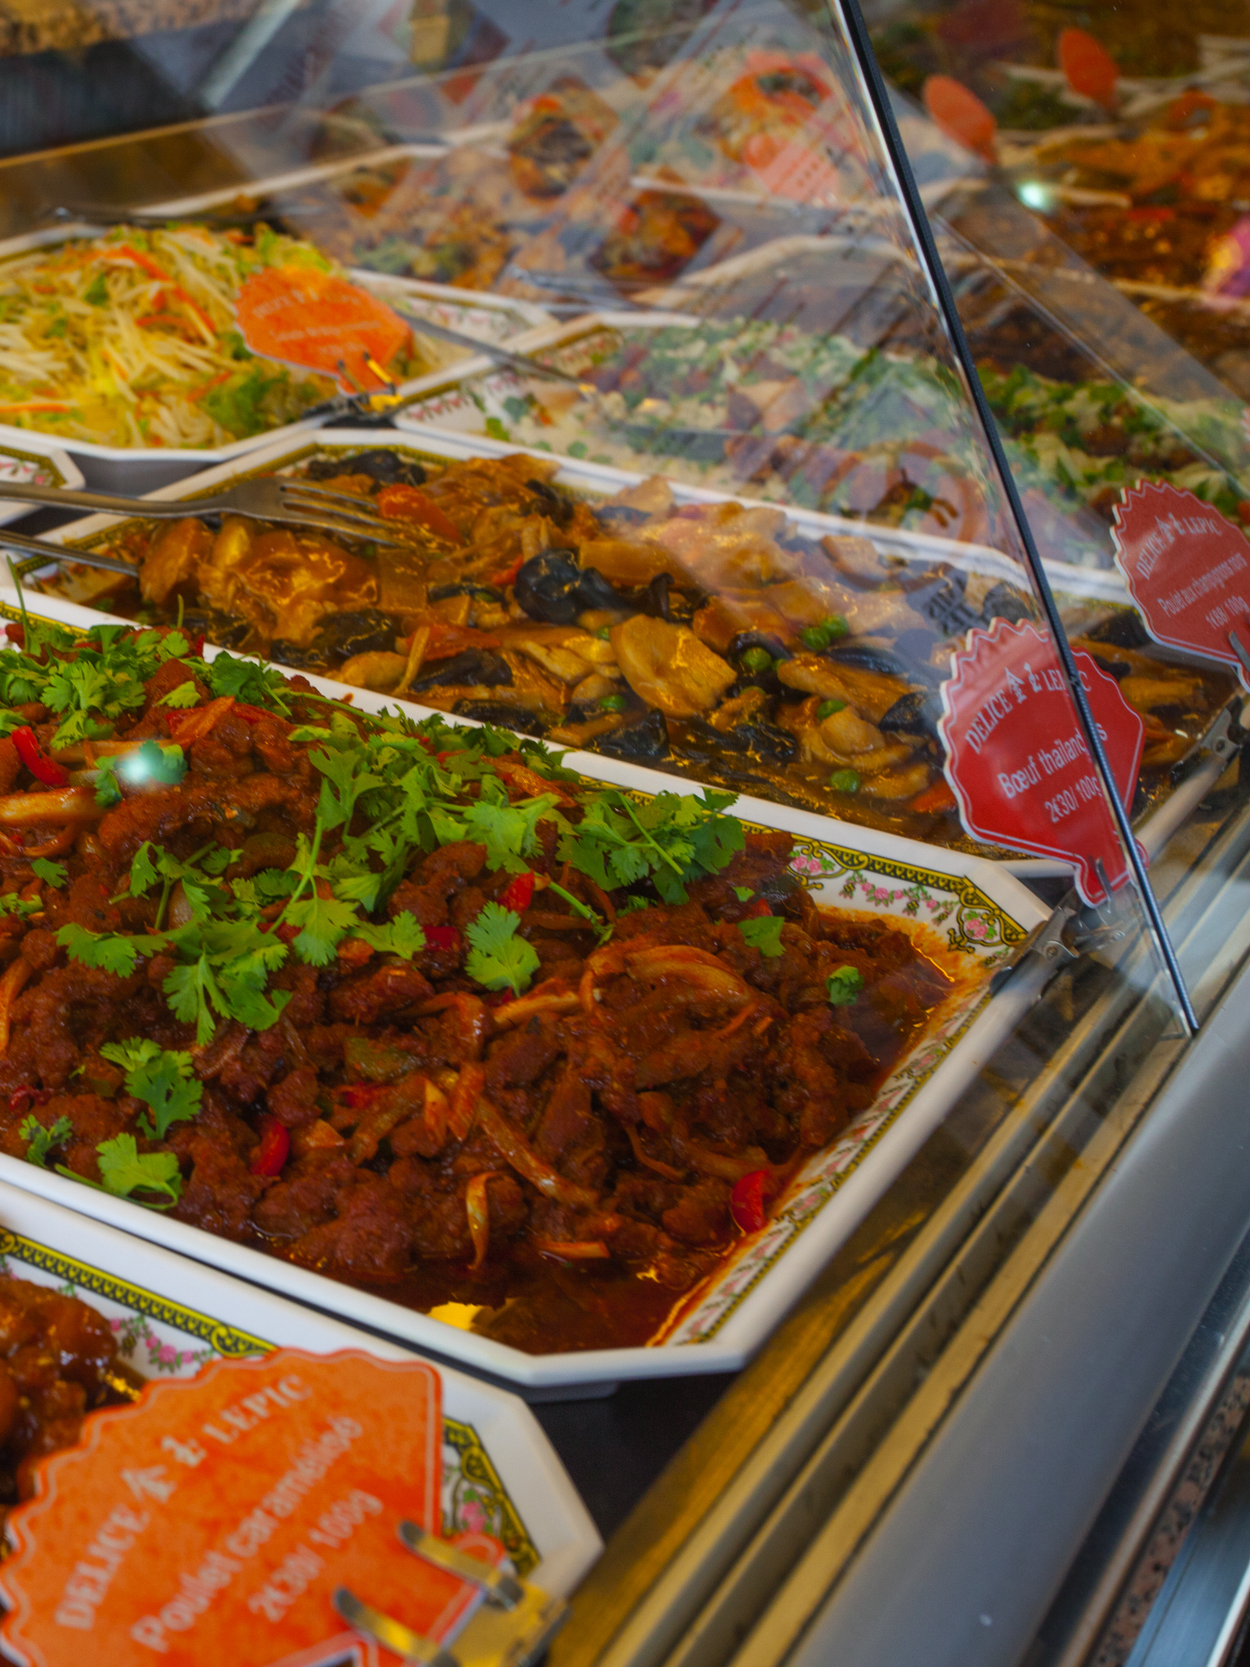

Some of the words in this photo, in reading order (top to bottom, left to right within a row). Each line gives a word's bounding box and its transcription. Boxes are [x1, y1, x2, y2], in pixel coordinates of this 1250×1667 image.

[1135, 531, 1167, 580] DELICE
[1182, 516, 1222, 536] LEPIC
[1157, 589, 1188, 618] Poulet
[1180, 585, 1199, 605] aux
[1191, 561, 1234, 597] champignons
[964, 689, 1013, 755] DELICE
[1040, 669, 1092, 692] LEC
[997, 755, 1042, 799] Bœuf
[1038, 722, 1108, 775] thaïlands
[55, 1504, 151, 1631] DELICE
[202, 1373, 313, 1444] LEPIC
[130, 1550, 243, 1653] Poulet
